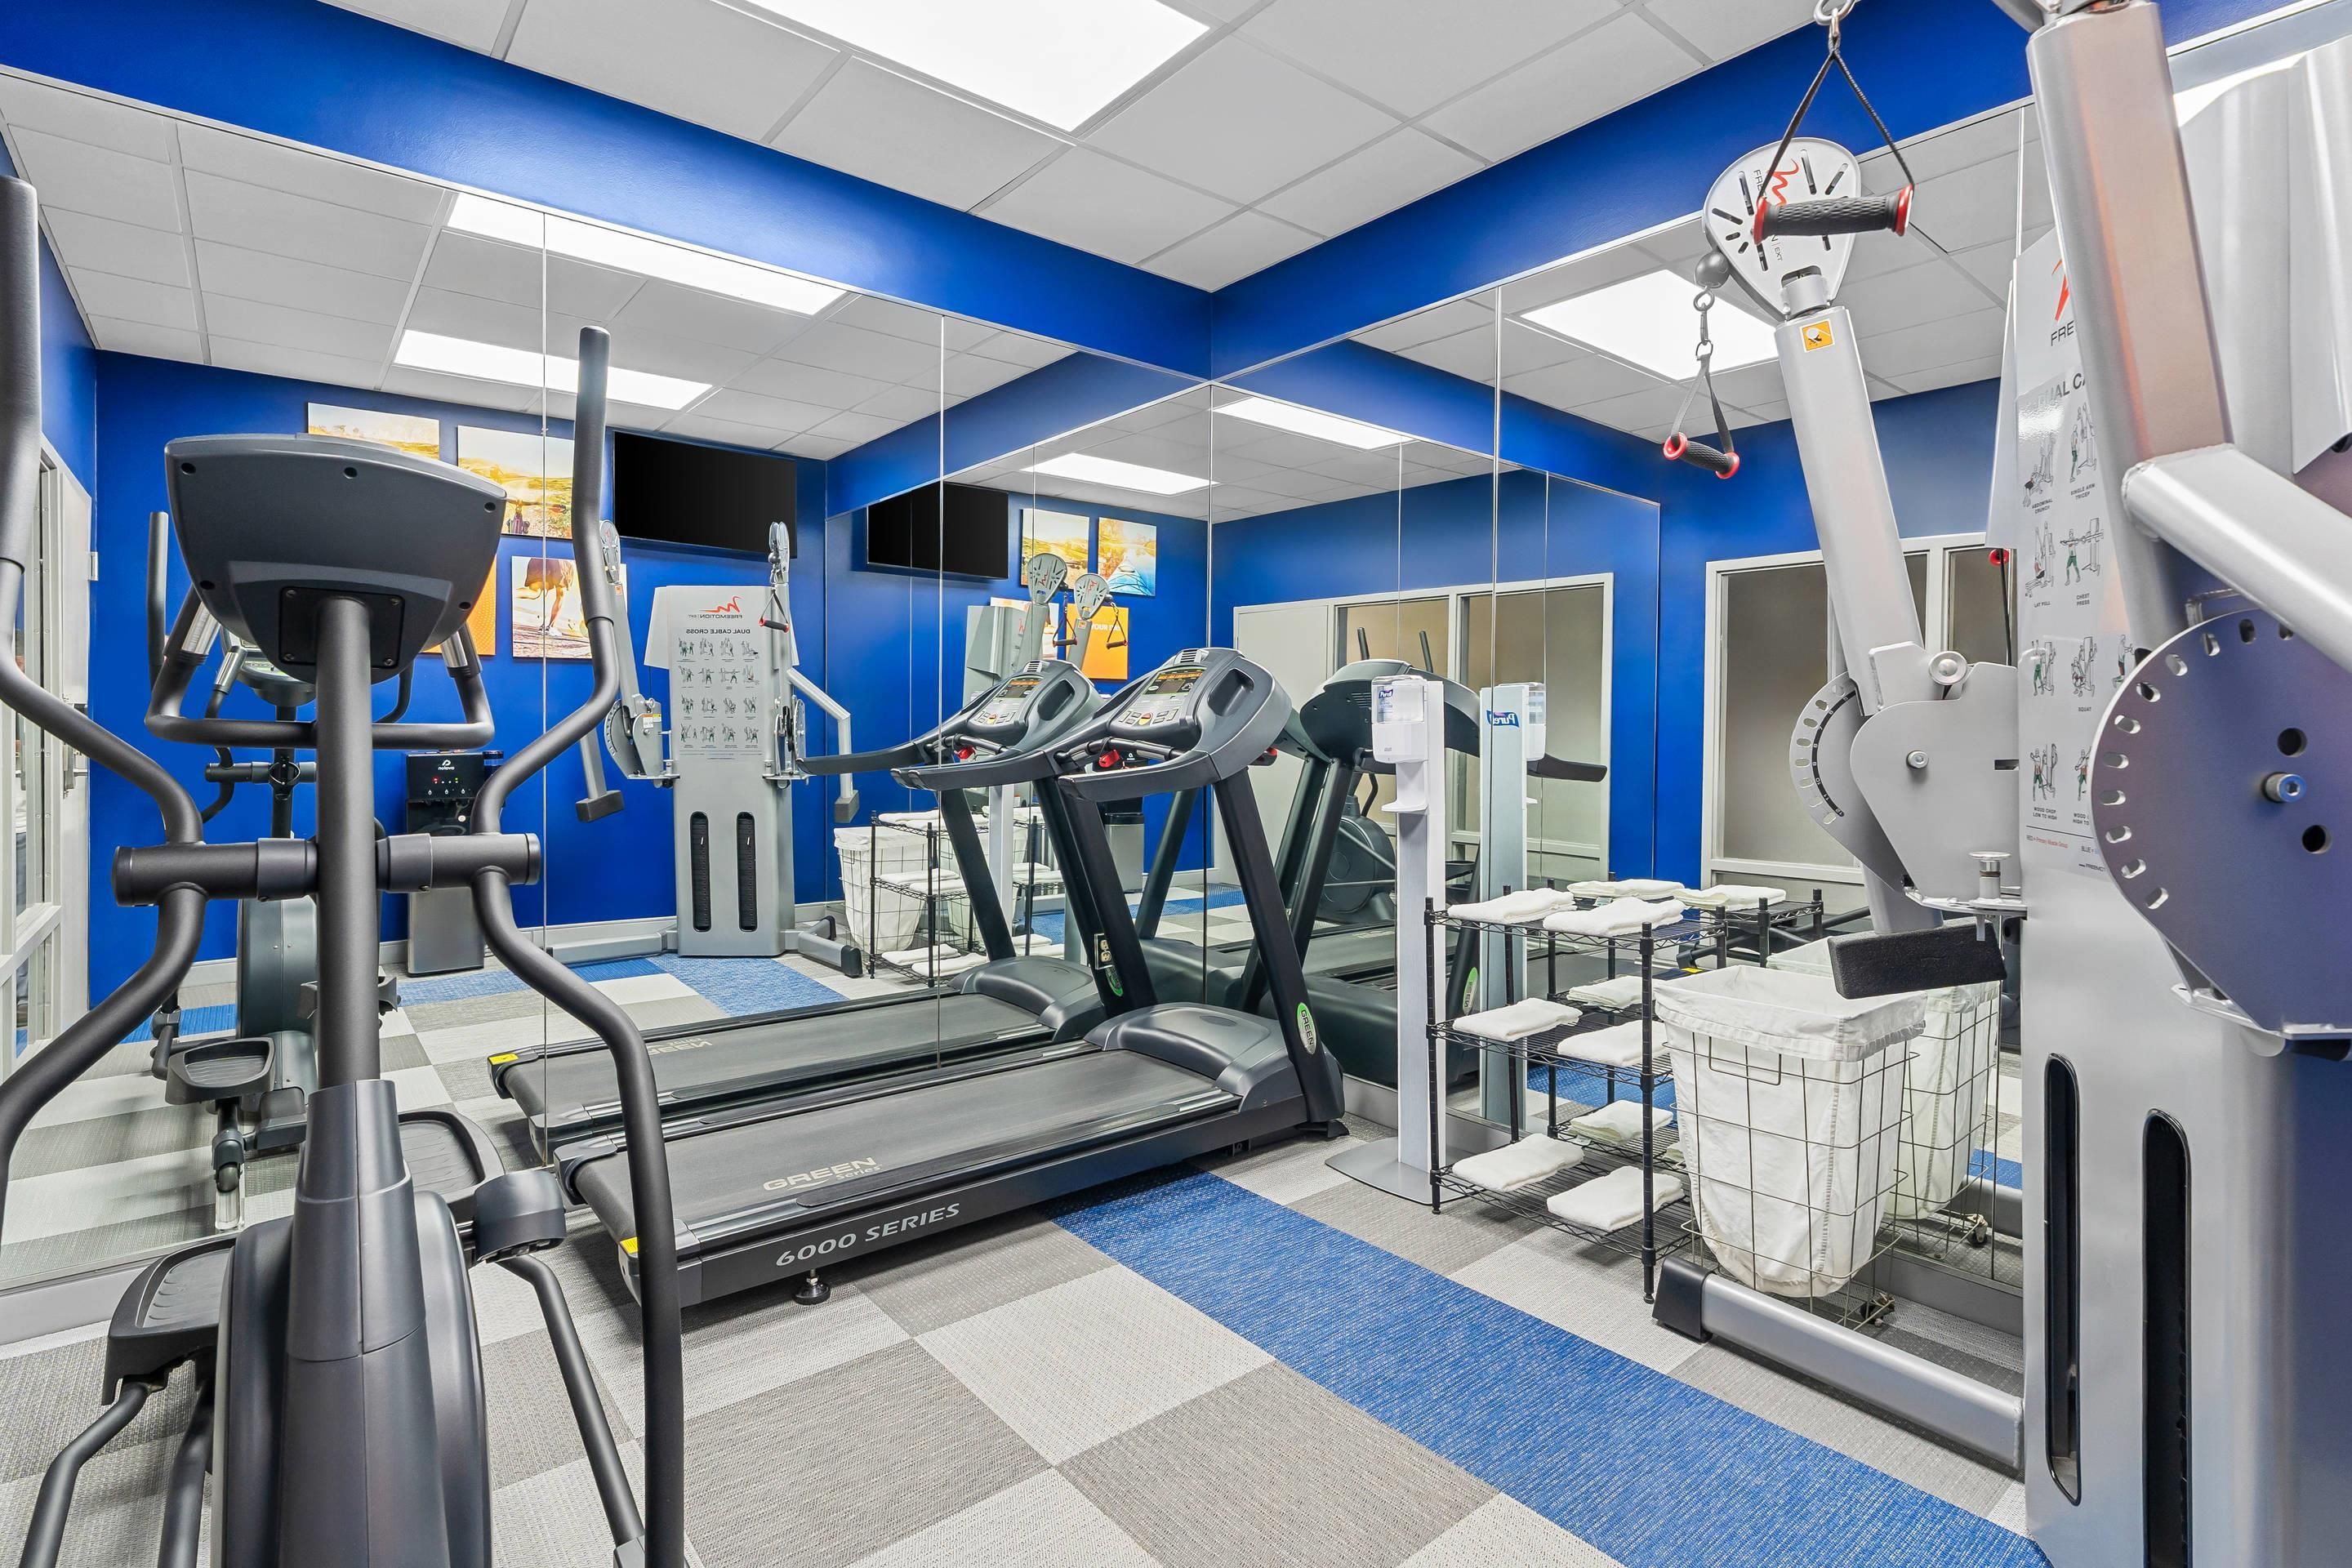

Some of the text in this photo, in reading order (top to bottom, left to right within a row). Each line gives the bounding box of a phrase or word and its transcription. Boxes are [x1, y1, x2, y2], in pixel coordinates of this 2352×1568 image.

[2073, 373, 2085, 390] C
[1301, 1009, 1314, 1045] GREEN
[763, 1156, 877, 1191] GREEN
[776, 1203, 960, 1266] 6000 SERIES
